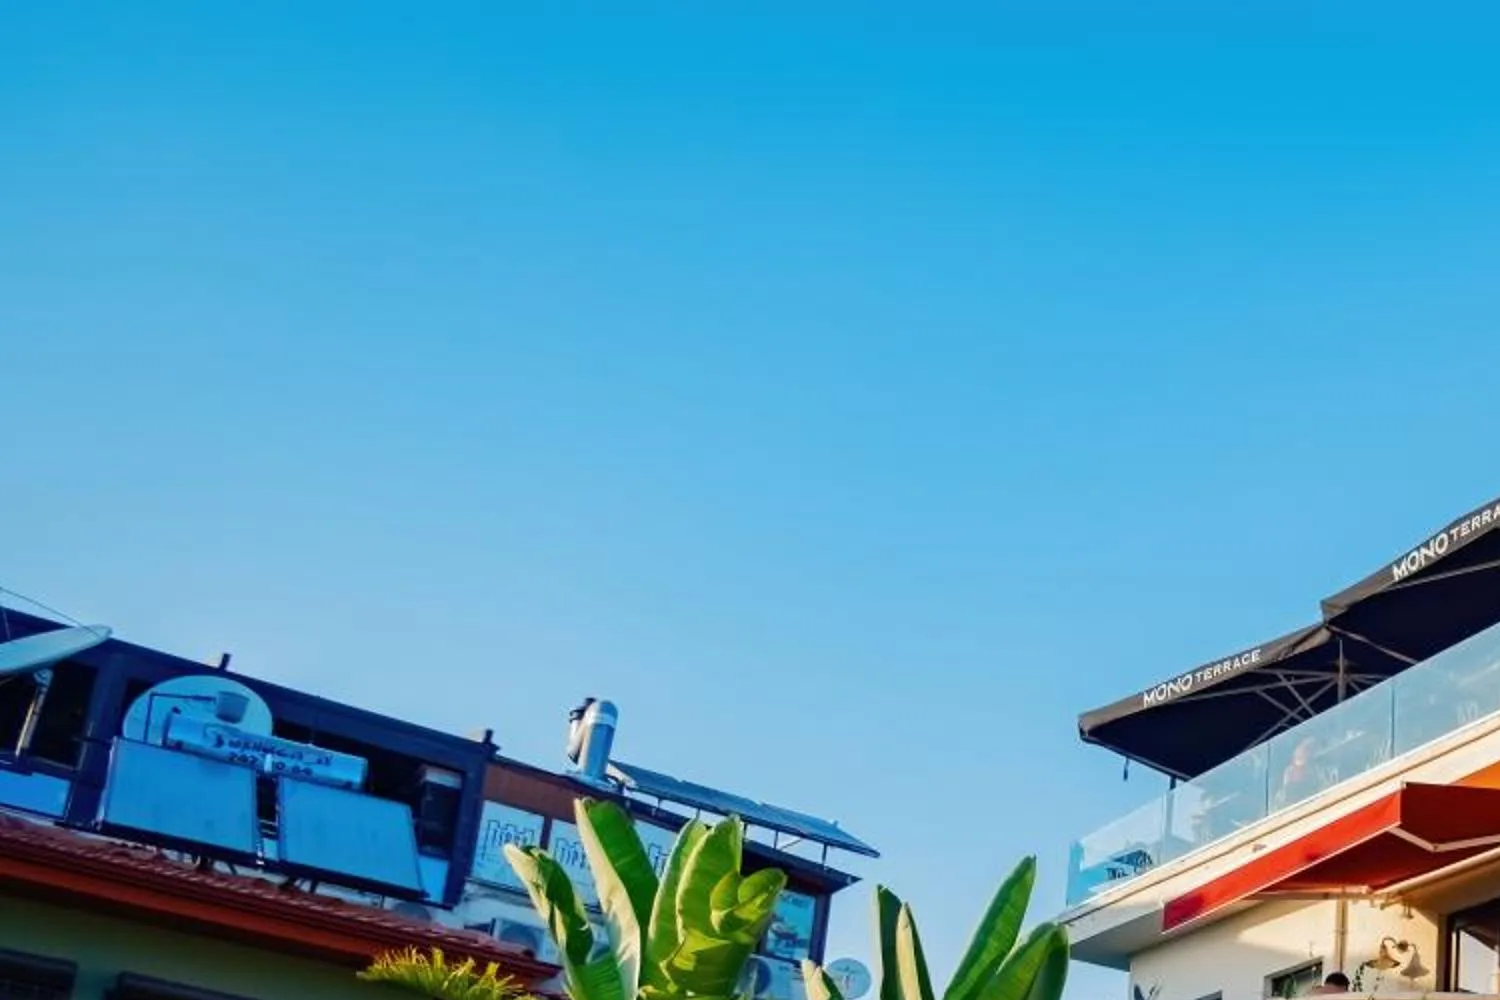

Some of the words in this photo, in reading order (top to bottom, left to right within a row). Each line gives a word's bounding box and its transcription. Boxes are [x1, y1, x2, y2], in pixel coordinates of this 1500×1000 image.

[1391, 531, 1449, 582] MONO
[1143, 676, 1193, 708] MONO
[1196, 650, 1261, 683] TERRACE
